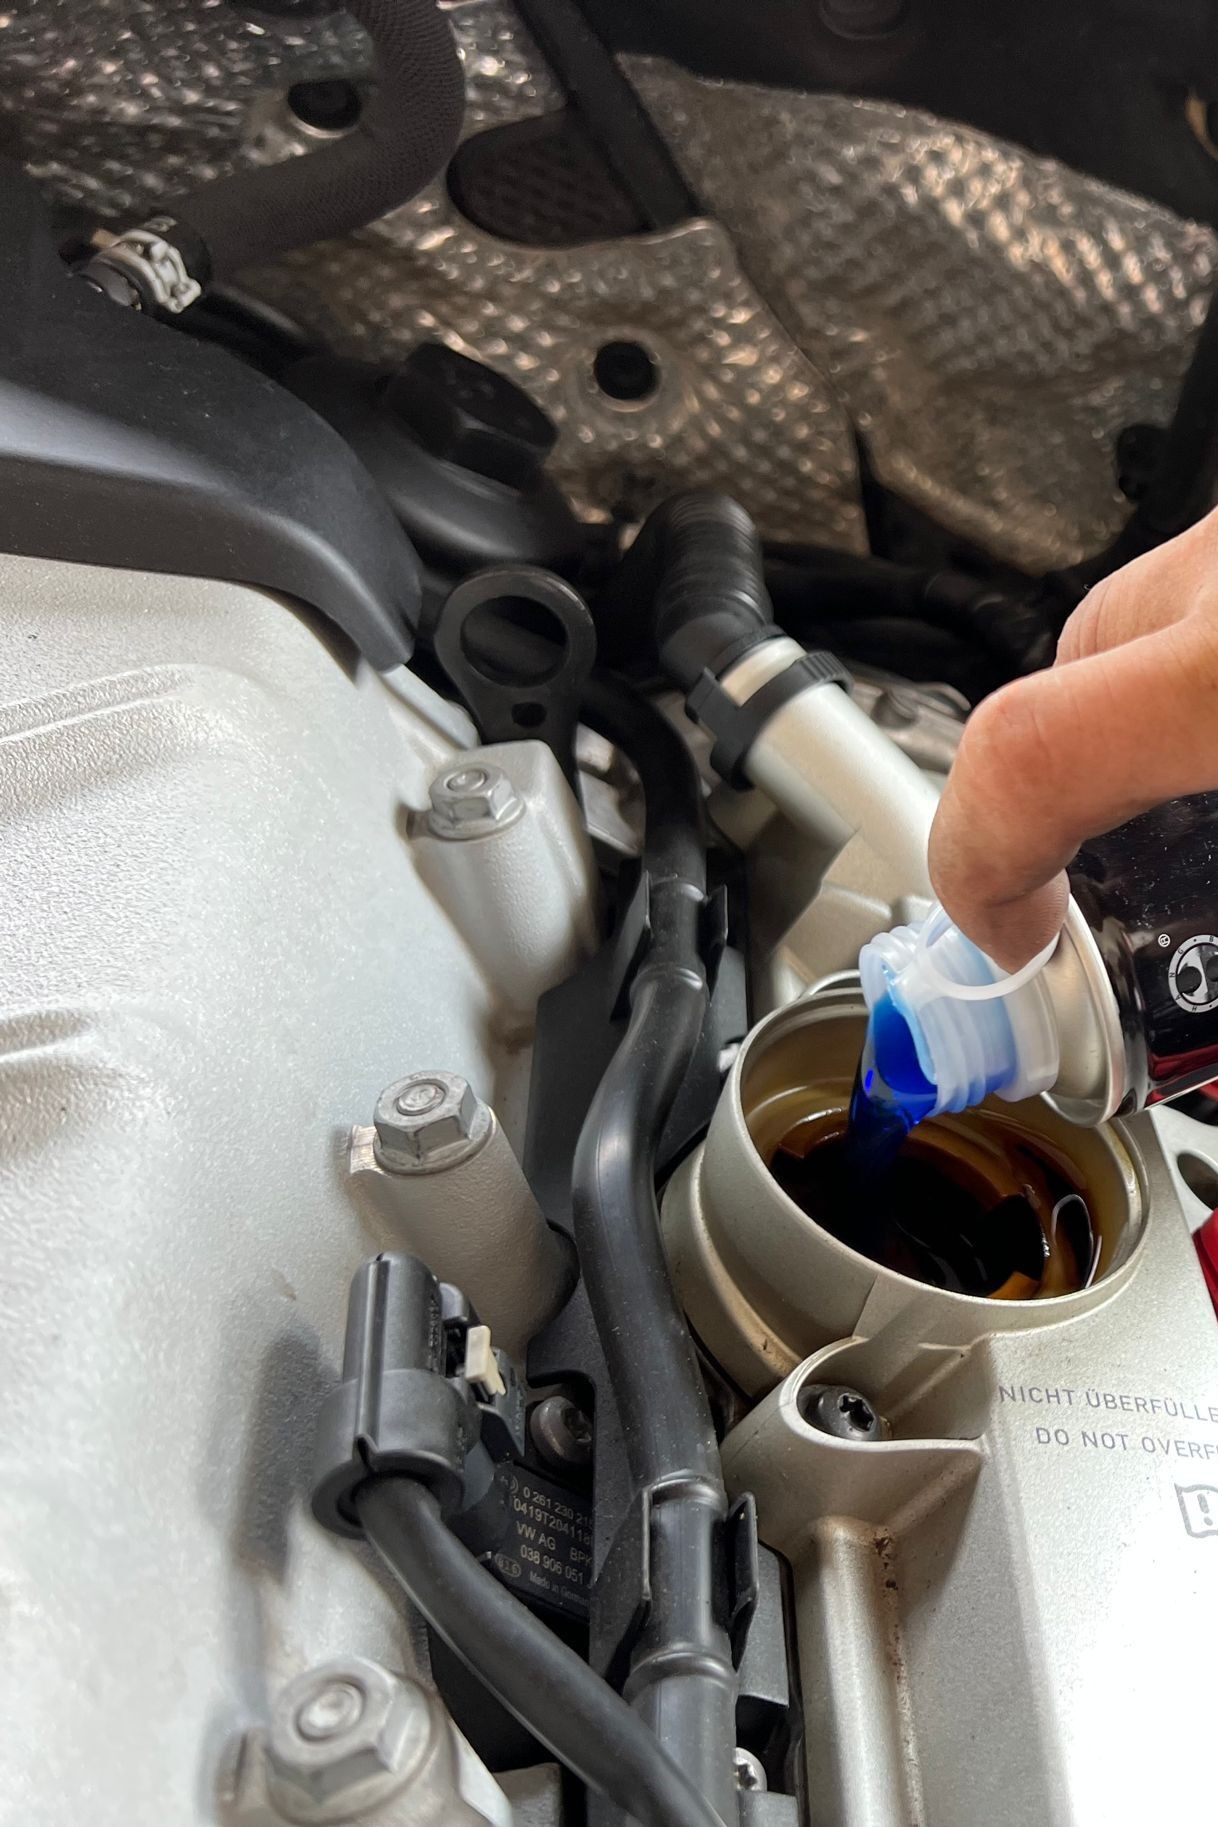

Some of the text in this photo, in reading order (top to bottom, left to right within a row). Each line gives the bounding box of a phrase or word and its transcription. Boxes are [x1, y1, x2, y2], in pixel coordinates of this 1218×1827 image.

[999, 1385, 1075, 1406] NICHT
[1036, 1427, 1069, 1446] DO
[1082, 1431, 1129, 1451] NOT
[523, 1486, 531, 1498] 0
[516, 1520, 536, 1541] VW
[538, 1532, 556, 1551] AG
[520, 1544, 584, 1585] 038 906 051
